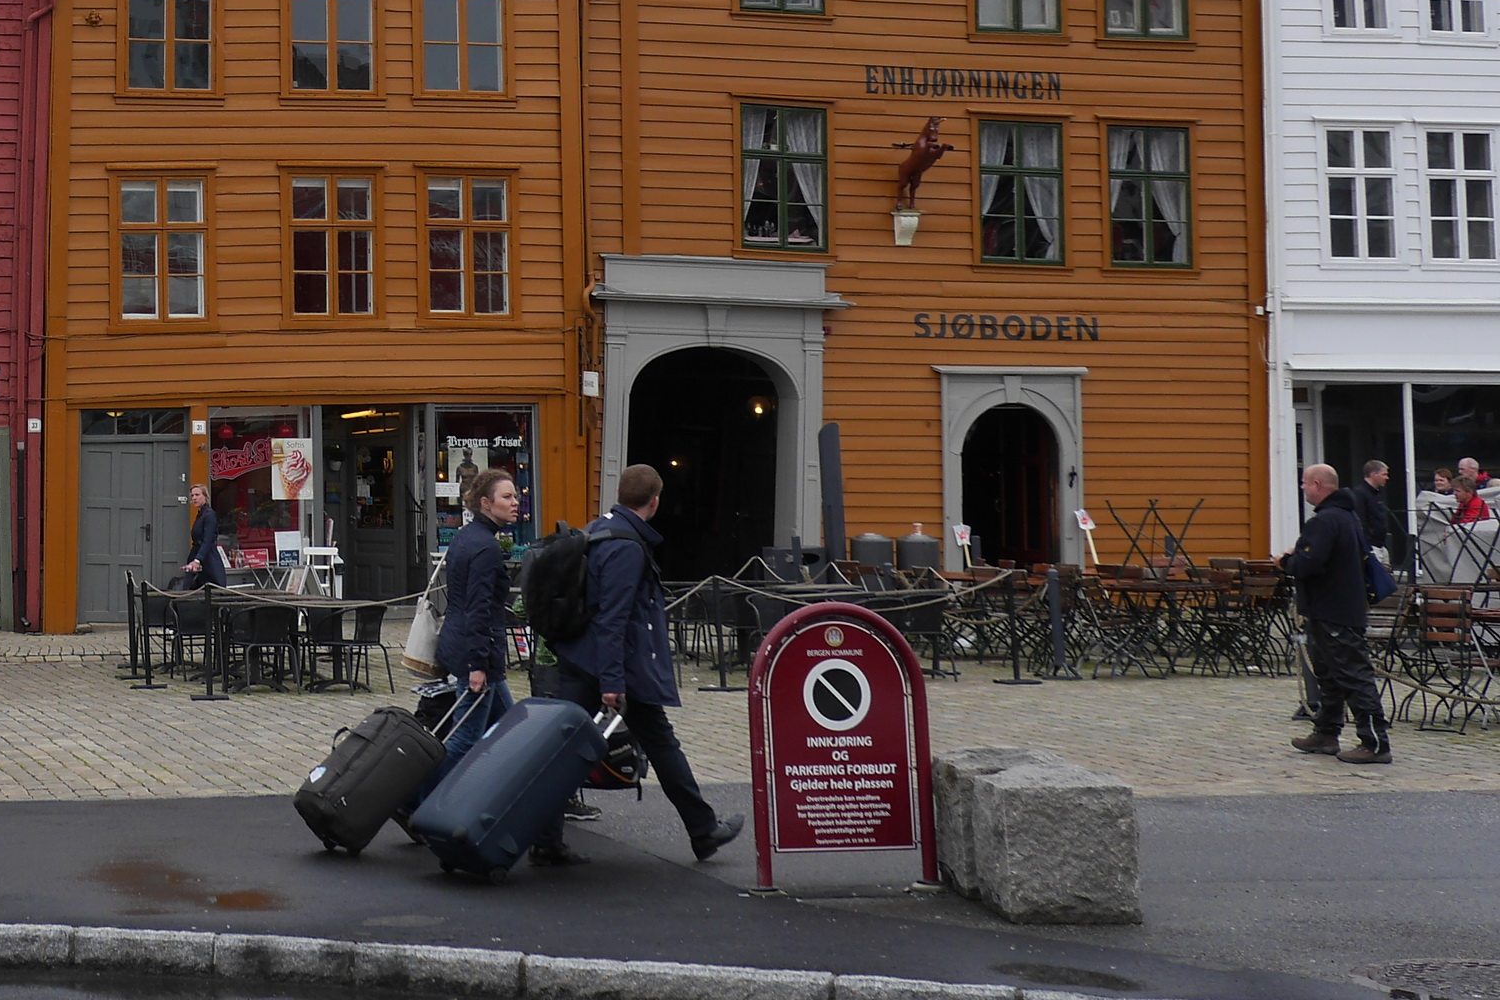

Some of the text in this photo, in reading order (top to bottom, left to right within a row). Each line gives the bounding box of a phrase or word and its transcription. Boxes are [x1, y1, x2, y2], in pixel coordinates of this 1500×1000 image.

[864, 64, 1061, 101] ENHJØRNINGEN
[913, 312, 1100, 342] SJØBODEN
[286, 441, 305, 449] Softis
[446, 435, 489, 448] Bryggen
[806, 648, 863, 657] BERGEN KOMMUNE
[806, 736, 873, 747] INNKJØRING
[831, 750, 849, 761] OG
[785, 763, 897, 776] PARKERING FORBUDT
[790, 778, 894, 792] Gjelder hele plassen
